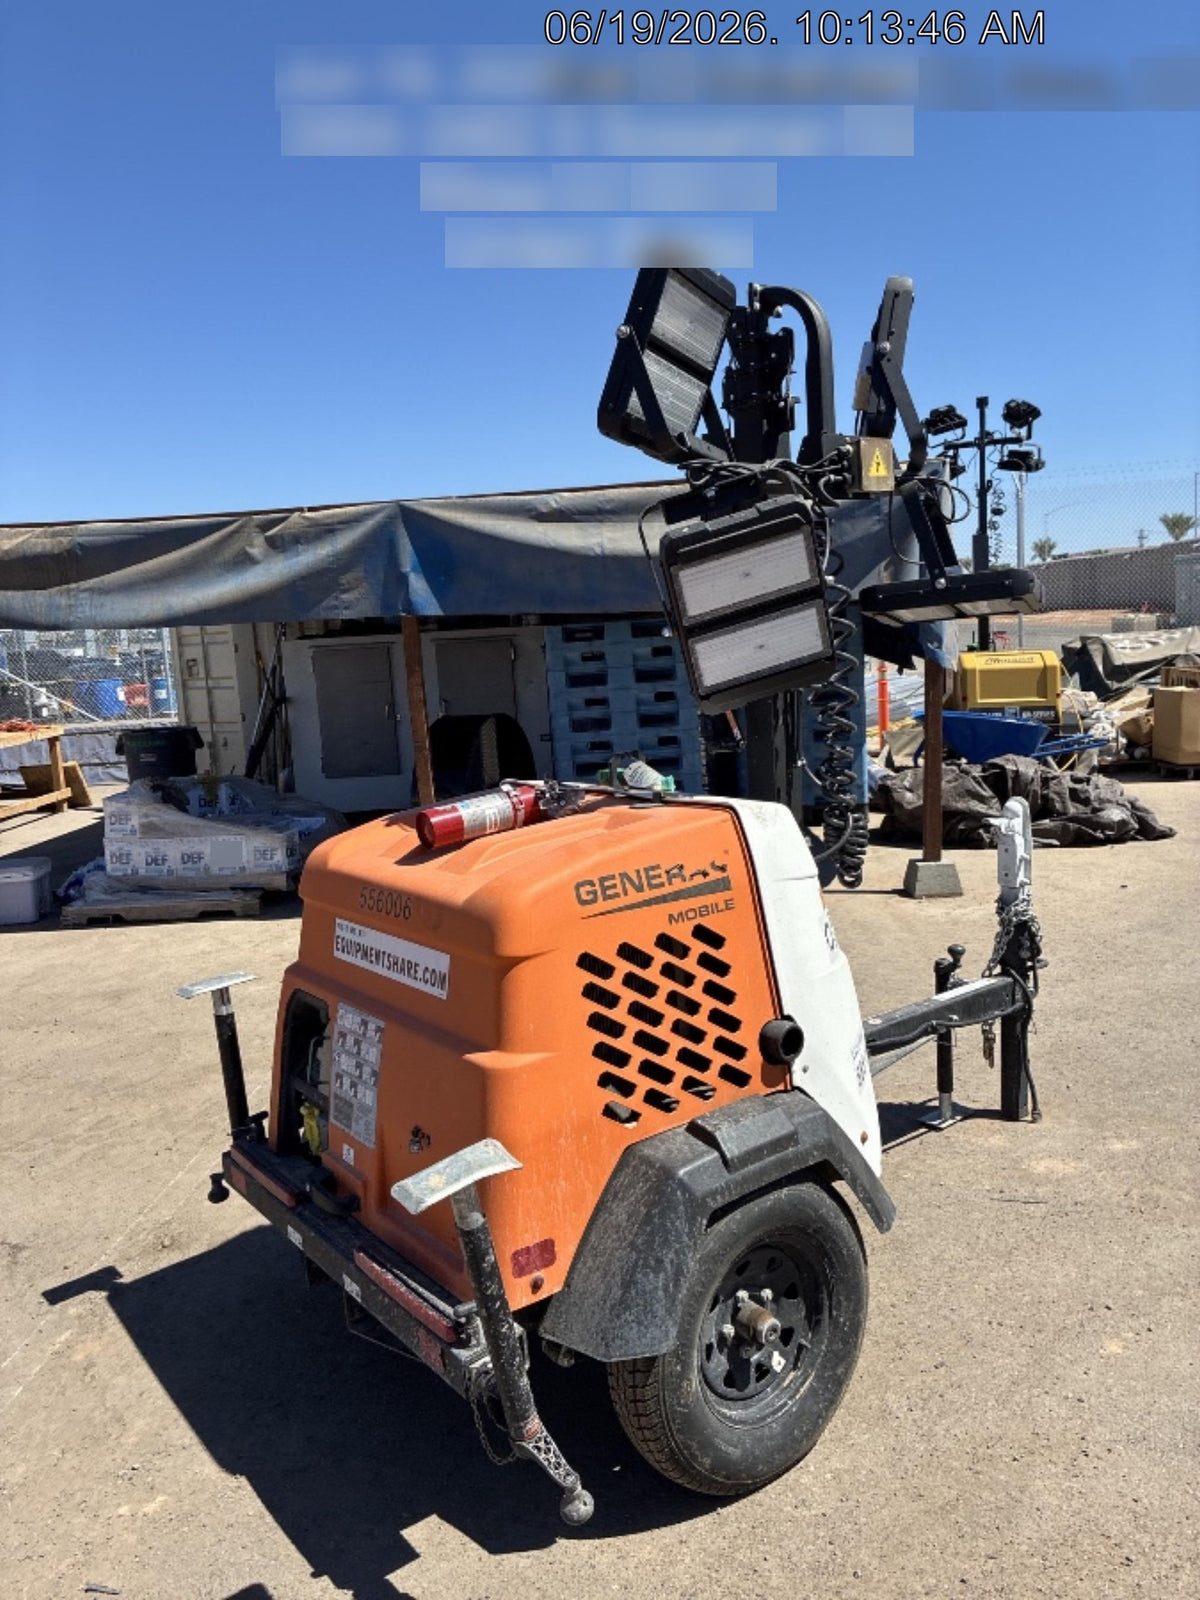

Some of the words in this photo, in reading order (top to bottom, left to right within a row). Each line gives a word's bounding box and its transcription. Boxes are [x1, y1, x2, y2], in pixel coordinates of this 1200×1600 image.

[109, 814, 132, 826] DEF
[145, 854, 169, 867] DEF
[181, 852, 205, 865] DEF
[253, 846, 278, 861] DEF
[667, 898, 735, 926] MOBILE
[335, 935, 448, 991] EQUIPMENTSHARE.COM
